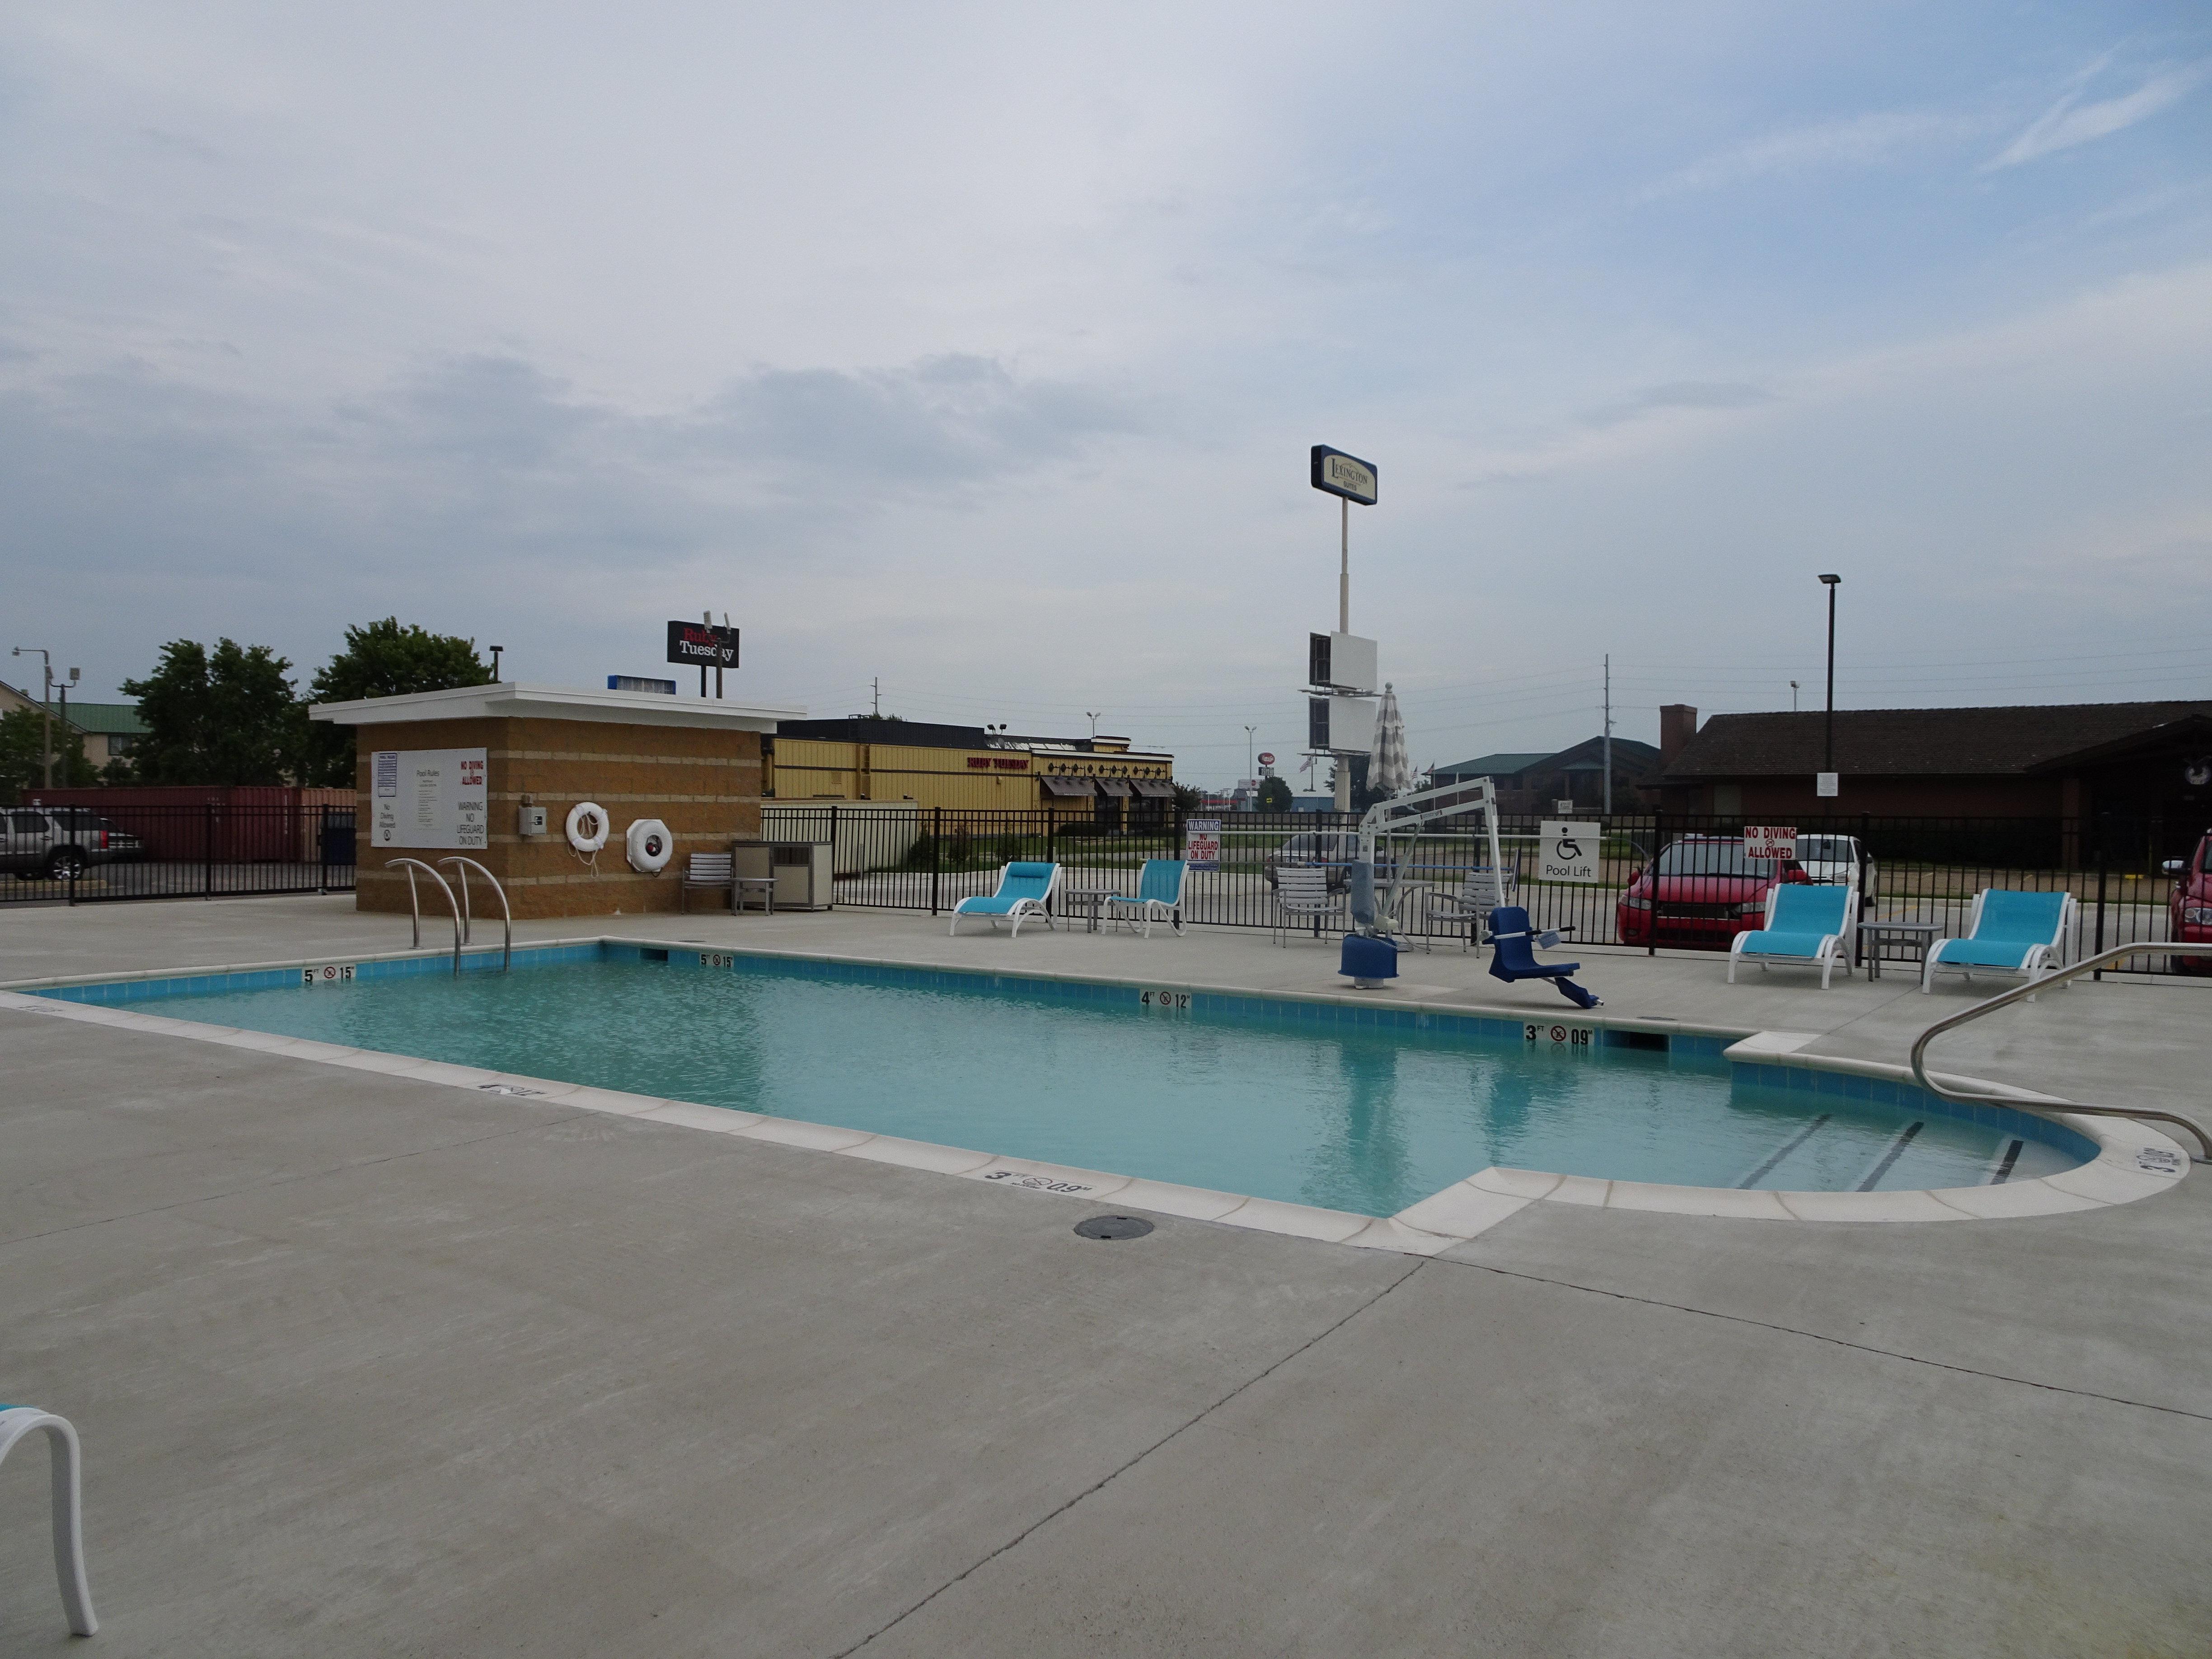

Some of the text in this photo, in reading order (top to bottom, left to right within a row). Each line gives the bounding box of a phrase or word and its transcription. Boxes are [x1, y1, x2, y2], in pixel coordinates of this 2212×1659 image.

[1331, 458, 1368, 484] LEXINGTON
[967, 757, 1029, 769] RUBY TUESDAY
[466, 813, 474, 822] NO
[457, 825, 484, 834] LIFEGUARD
[1188, 821, 1219, 830] WARNING
[1745, 827, 1795, 839] NO DIVING
[1188, 841, 1218, 850] LIFEGUARD
[1190, 850, 1215, 859] ON DUTY
[1748, 847, 1792, 859] ALLOWED
[1546, 865, 1591, 877] Pool Lift
